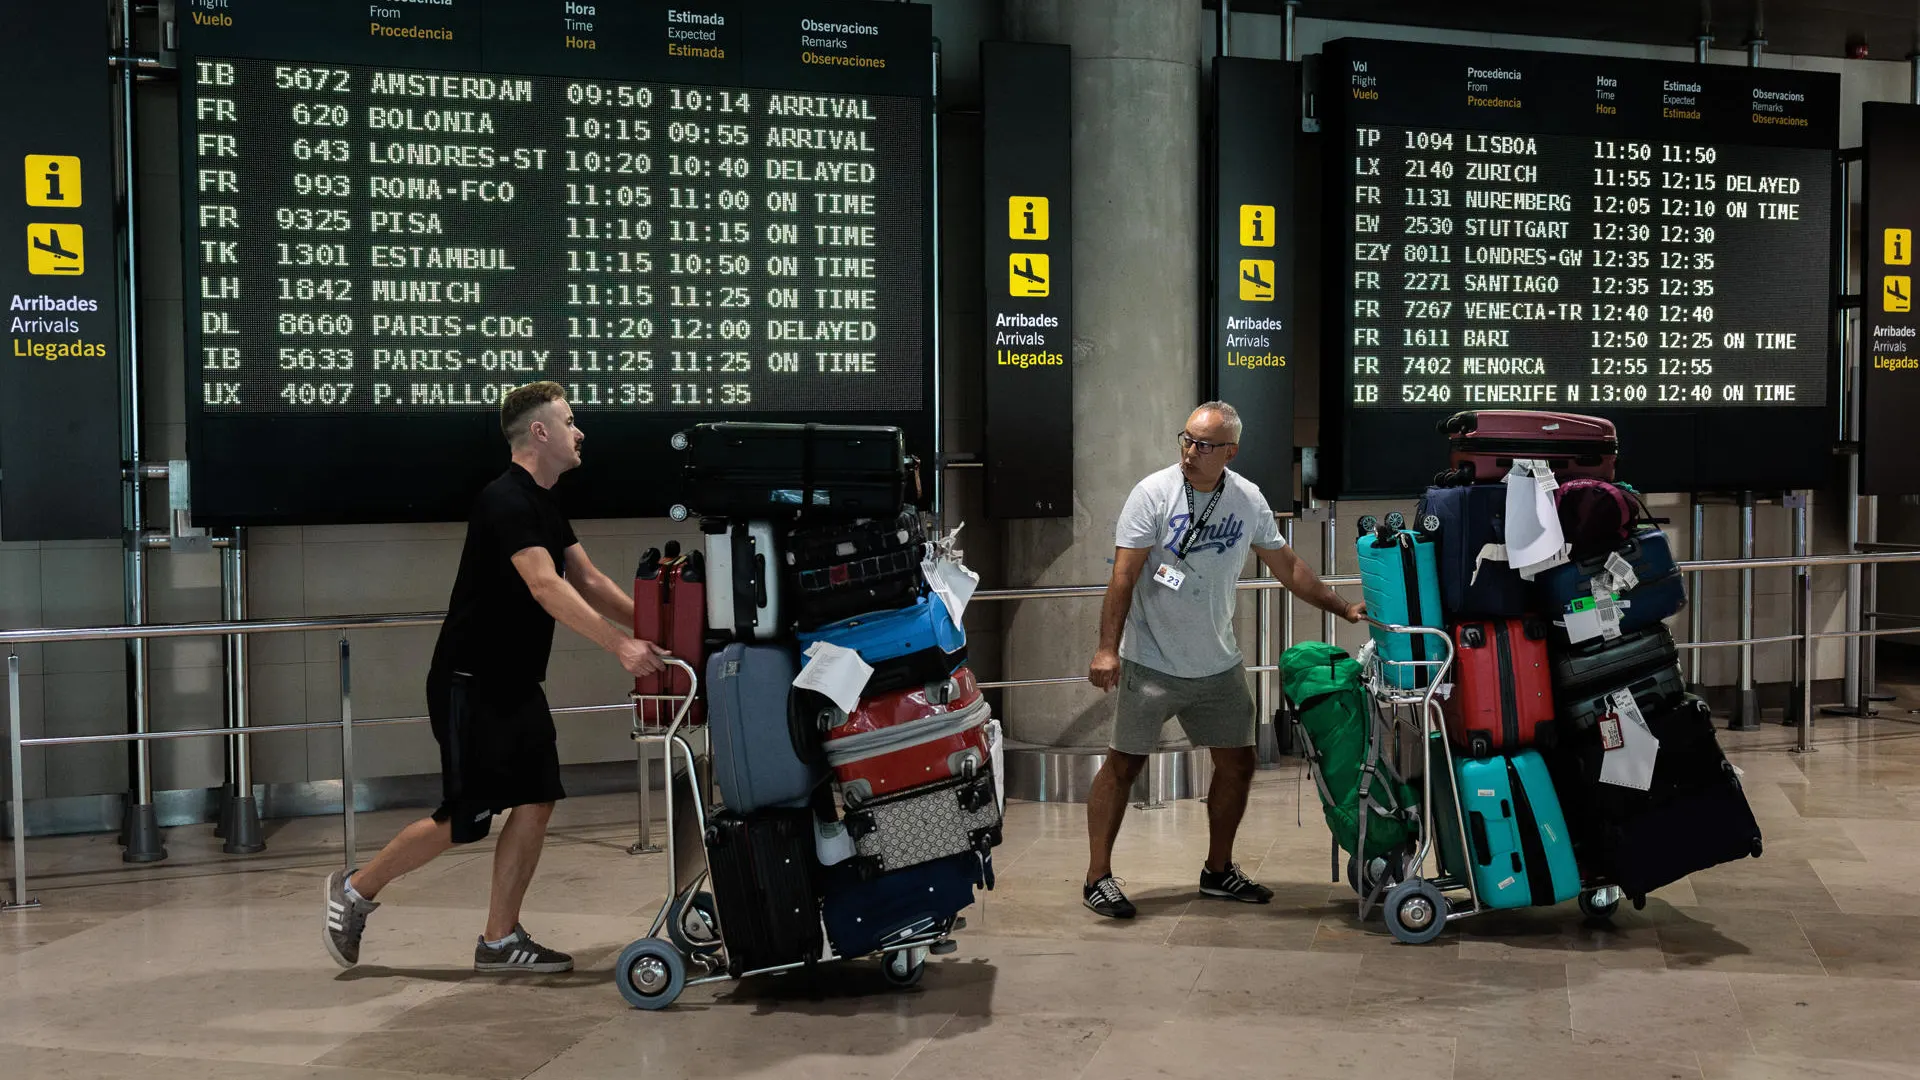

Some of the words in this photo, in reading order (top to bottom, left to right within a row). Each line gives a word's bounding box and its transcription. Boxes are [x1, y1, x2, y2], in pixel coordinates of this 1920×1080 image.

[370, 5, 400, 18] From
[565, 2, 596, 16] Hora
[668, 10, 725, 26] Estimada
[192, 12, 233, 26] Vuelo
[564, 18, 593, 32] Time
[801, 19, 879, 36] Observacions
[371, 23, 454, 40] Procedencia
[668, 27, 716, 41] Expected
[565, 35, 596, 50] Hora
[668, 44, 725, 59] Estimada
[802, 36, 848, 49] Remarks
[802, 52, 886, 68] Observaciones
[1353, 61, 1368, 72] Vol
[1597, 76, 1617, 87] Hora
[1664, 80, 1701, 92] Estimada
[198, 63, 233, 85] IB
[277, 67, 349, 91] 5672
[371, 73, 531, 101] AMSTERDAM
[568, 84, 651, 107] 09:50
[671, 90, 750, 112] 10:14
[769, 95, 875, 119] ARRIVAL
[198, 98, 236, 121] FR
[293, 104, 348, 126] 620
[370, 107, 494, 133] BOLONIA
[566, 117, 650, 140] 10:15
[669, 123, 748, 145] 09:55
[767, 127, 874, 151] ARRIVAL
[1357, 129, 1380, 146] TP
[1406, 132, 1452, 150] 1094
[1467, 135, 1536, 154] LISBOA
[1595, 142, 1650, 160] 11:50
[1663, 145, 1716, 163] 11:50
[199, 134, 237, 156] FR
[294, 139, 349, 161] 643
[370, 142, 546, 169] LONDRES-ST
[567, 151, 650, 173] 10:20
[670, 155, 748, 177] 10:40
[767, 159, 875, 182] DELAYED
[1357, 158, 1379, 175] LX
[1406, 160, 1453, 178] 2140
[1467, 163, 1536, 182] ZURICH
[1595, 169, 1650, 187] 11:55
[1663, 172, 1715, 190] 12:15
[1727, 175, 1799, 194] DELAYED
[200, 170, 238, 192] FR
[295, 174, 349, 196] 993
[371, 177, 514, 202] ROMA-FCO
[567, 184, 651, 206] 11:05
[670, 188, 749, 210] 11:00
[767, 192, 797, 212] ON
[815, 194, 875, 214] TIME
[1357, 186, 1380, 203] FR
[1406, 188, 1451, 206] 1131
[1467, 191, 1570, 211] NUREMBERG
[1595, 196, 1650, 214] 12:05
[1662, 199, 1715, 216] 12:10
[1727, 202, 1747, 218] ON
[1759, 203, 1799, 220] TIME
[201, 206, 239, 227] FR
[277, 209, 350, 231] 9325
[371, 212, 442, 233] PISA
[568, 218, 651, 239] 11:10
[670, 221, 749, 242] 11:15
[767, 224, 797, 244] ON
[815, 225, 875, 246] TIME
[1356, 215, 1379, 232] EW
[1406, 217, 1452, 234] 2530
[1466, 219, 1568, 238] STUTTGART
[1594, 223, 1649, 241] 12:30
[1662, 226, 1714, 243] 12:30
[202, 241, 237, 263] TK
[278, 244, 348, 265] 1301
[372, 246, 514, 269] ESTAMBUL
[568, 251, 652, 272] 11:15
[671, 254, 749, 275] 10:50
[768, 256, 797, 276] ON
[815, 257, 875, 277] TIME
[1356, 243, 1390, 260] EZY
[1405, 245, 1450, 262] 8011
[1466, 247, 1582, 266] LONDRES-GW
[1594, 250, 1649, 267] 12:35
[1661, 252, 1714, 269] 12:35
[202, 277, 238, 298] LH
[279, 279, 351, 300] 1842
[373, 281, 479, 302] MUNICH
[568, 284, 652, 305] 11:15
[671, 286, 750, 307] 11:25
[768, 288, 798, 308] ON
[815, 289, 875, 309] TIME
[1356, 272, 1380, 288] FR
[1405, 273, 1450, 290] 2271
[1465, 275, 1558, 292] SANTIAGO
[1593, 277, 1648, 294] 12:35
[1661, 279, 1713, 296] 12:35
[10, 295, 98, 312] Arribades
[1355, 300, 1379, 317] FR
[1405, 301, 1451, 318] 7267
[1465, 302, 1582, 320] VENECIA-TR
[1593, 304, 1648, 321] 12:40
[1661, 305, 1713, 322] 12:40
[11, 317, 79, 333] Arrivals
[203, 312, 239, 333] DL
[279, 314, 352, 335] 8660
[373, 315, 532, 337] PARIS-CDG
[569, 318, 652, 338] 11:20
[671, 319, 750, 339] 12:00
[768, 320, 876, 340] DELAYED
[996, 313, 1058, 328] Arribades
[1226, 316, 1282, 330] Arribades
[996, 332, 1045, 346] Arrivals
[1355, 329, 1379, 345] FR
[1404, 329, 1449, 346] 1611
[1464, 330, 1509, 346] BARI
[1592, 331, 1648, 348] 12:50
[1660, 332, 1713, 348] 12:25
[1724, 333, 1744, 348] ON
[1756, 333, 1796, 349] TIME
[1874, 325, 1916, 337] Arribades
[14, 339, 106, 361] Llegadas
[1226, 334, 1270, 348] Arrivals
[204, 348, 240, 368] IB
[280, 349, 353, 369] 5633
[374, 350, 549, 370] PARIS-ORLY
[569, 351, 653, 371] 11:25
[672, 352, 750, 371] 11:25
[768, 352, 798, 372] ON
[816, 353, 875, 372] TIME
[998, 350, 1064, 368] Llegadas
[1228, 352, 1286, 370] Llegadas
[1354, 357, 1379, 374] FR
[1404, 357, 1451, 374] 7402
[1464, 358, 1545, 374] MENORCA
[1592, 358, 1647, 374] 12:55
[1659, 359, 1712, 375] 12:55
[1874, 356, 1919, 371] Llegadas
[205, 383, 240, 404] UX
[281, 384, 353, 404] 4007
[569, 384, 653, 404] 11:35
[672, 384, 750, 403] 11:35
[1355, 385, 1378, 402] IB
[1403, 385, 1450, 402] 5240
[1464, 385, 1557, 402] TENERIFE
[1568, 385, 1579, 401] N
[1591, 385, 1647, 401] 13:00
[1659, 385, 1712, 401] 12:40
[1723, 385, 1743, 401] ON
[1755, 385, 1795, 401] TIME
[1201, 492, 1221, 522] HOSTELCO
[1164, 512, 1243, 549] Fmily
